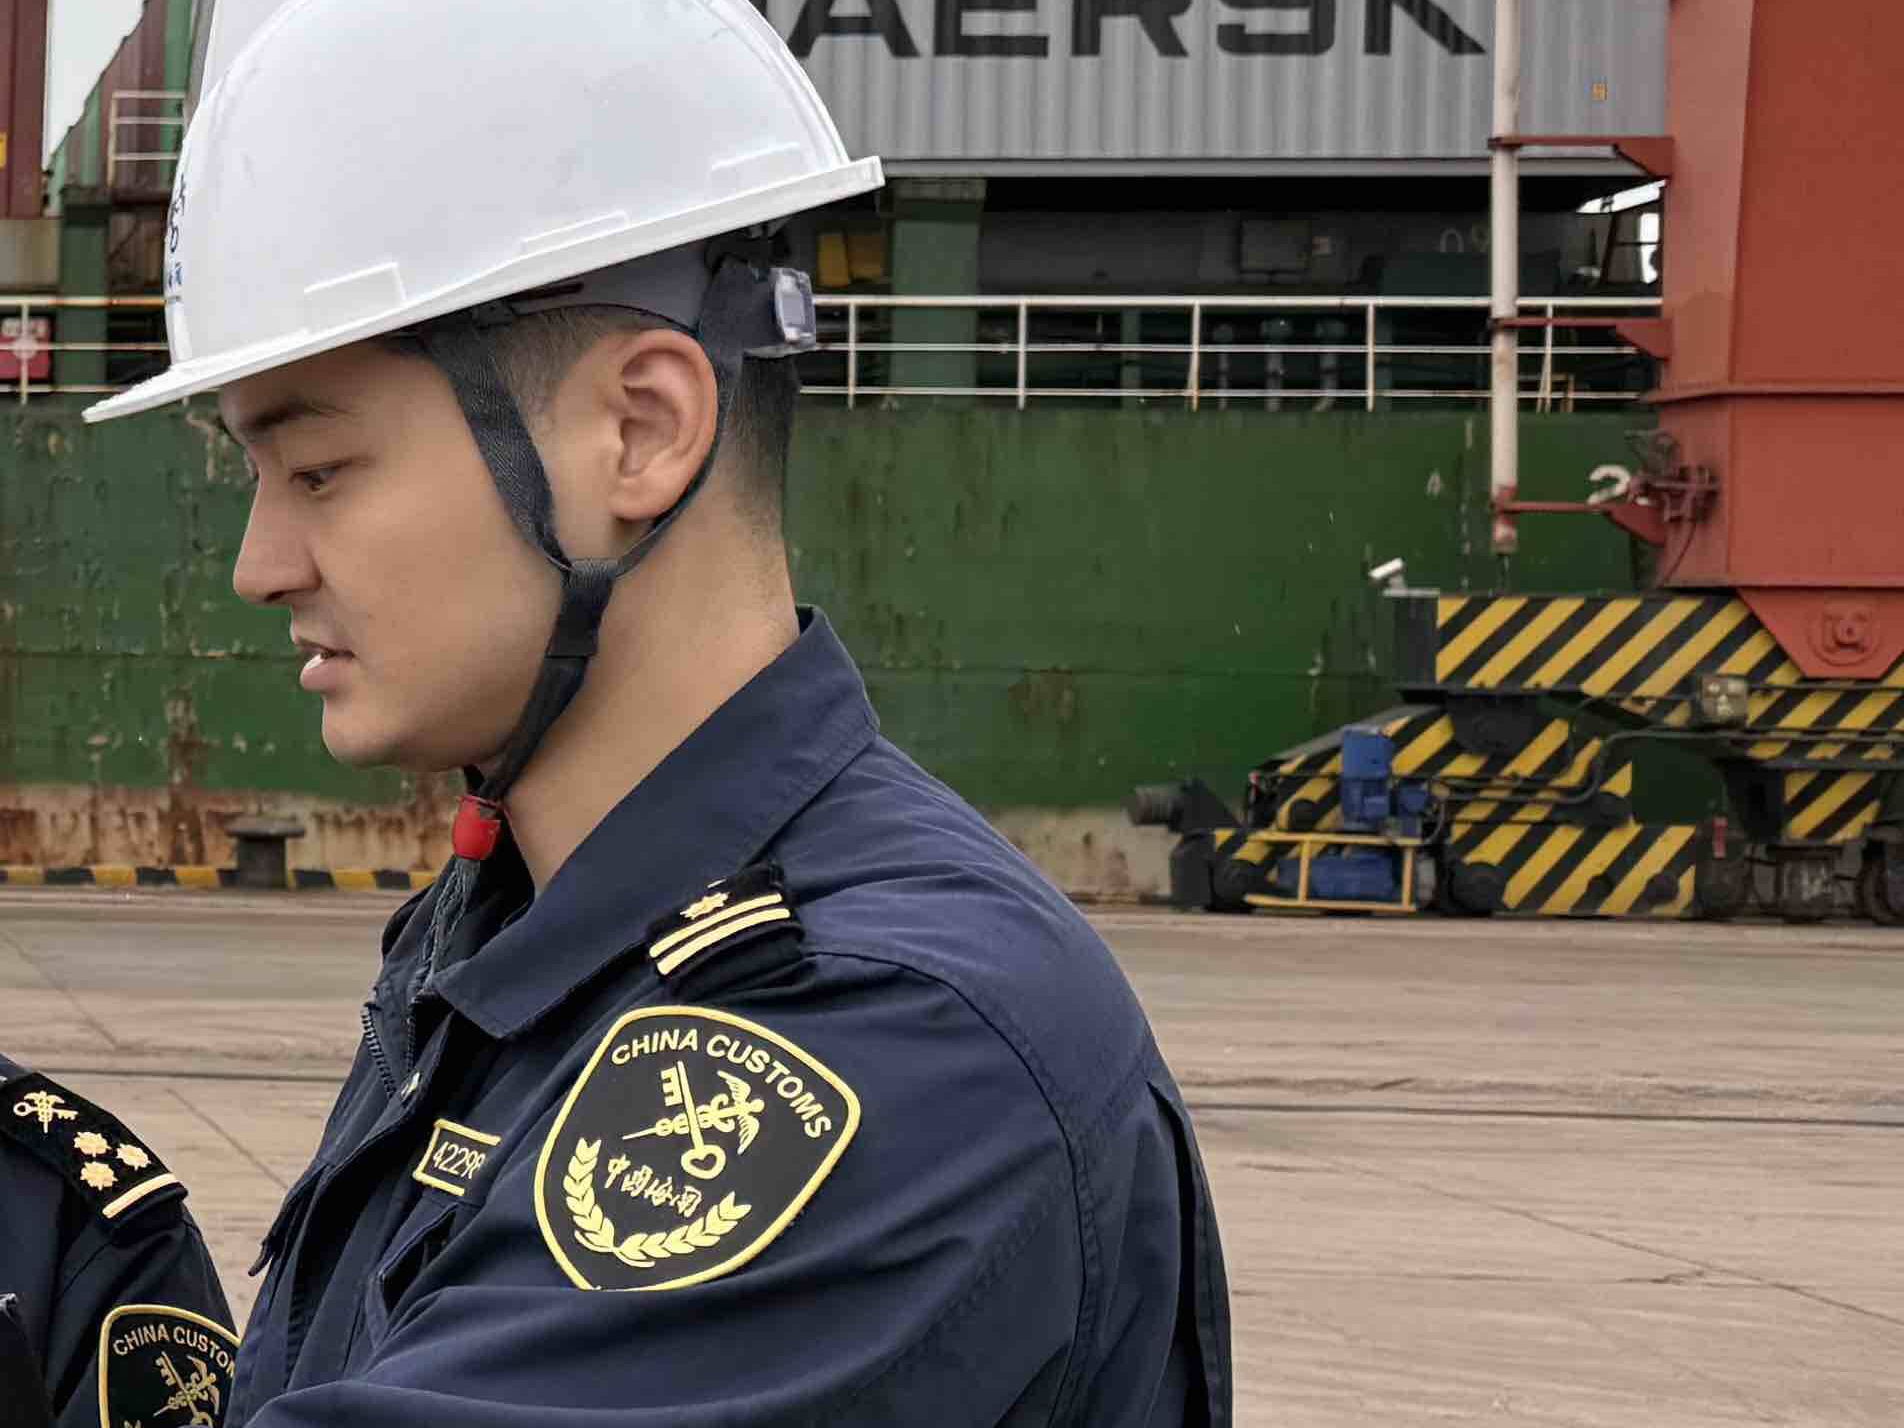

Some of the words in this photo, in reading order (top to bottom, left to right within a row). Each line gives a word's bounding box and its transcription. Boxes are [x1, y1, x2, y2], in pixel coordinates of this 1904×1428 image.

[611, 1028, 699, 1066] CHINA
[705, 1033, 833, 1140] CUSTOMS
[112, 1323, 170, 1356] CHINA
